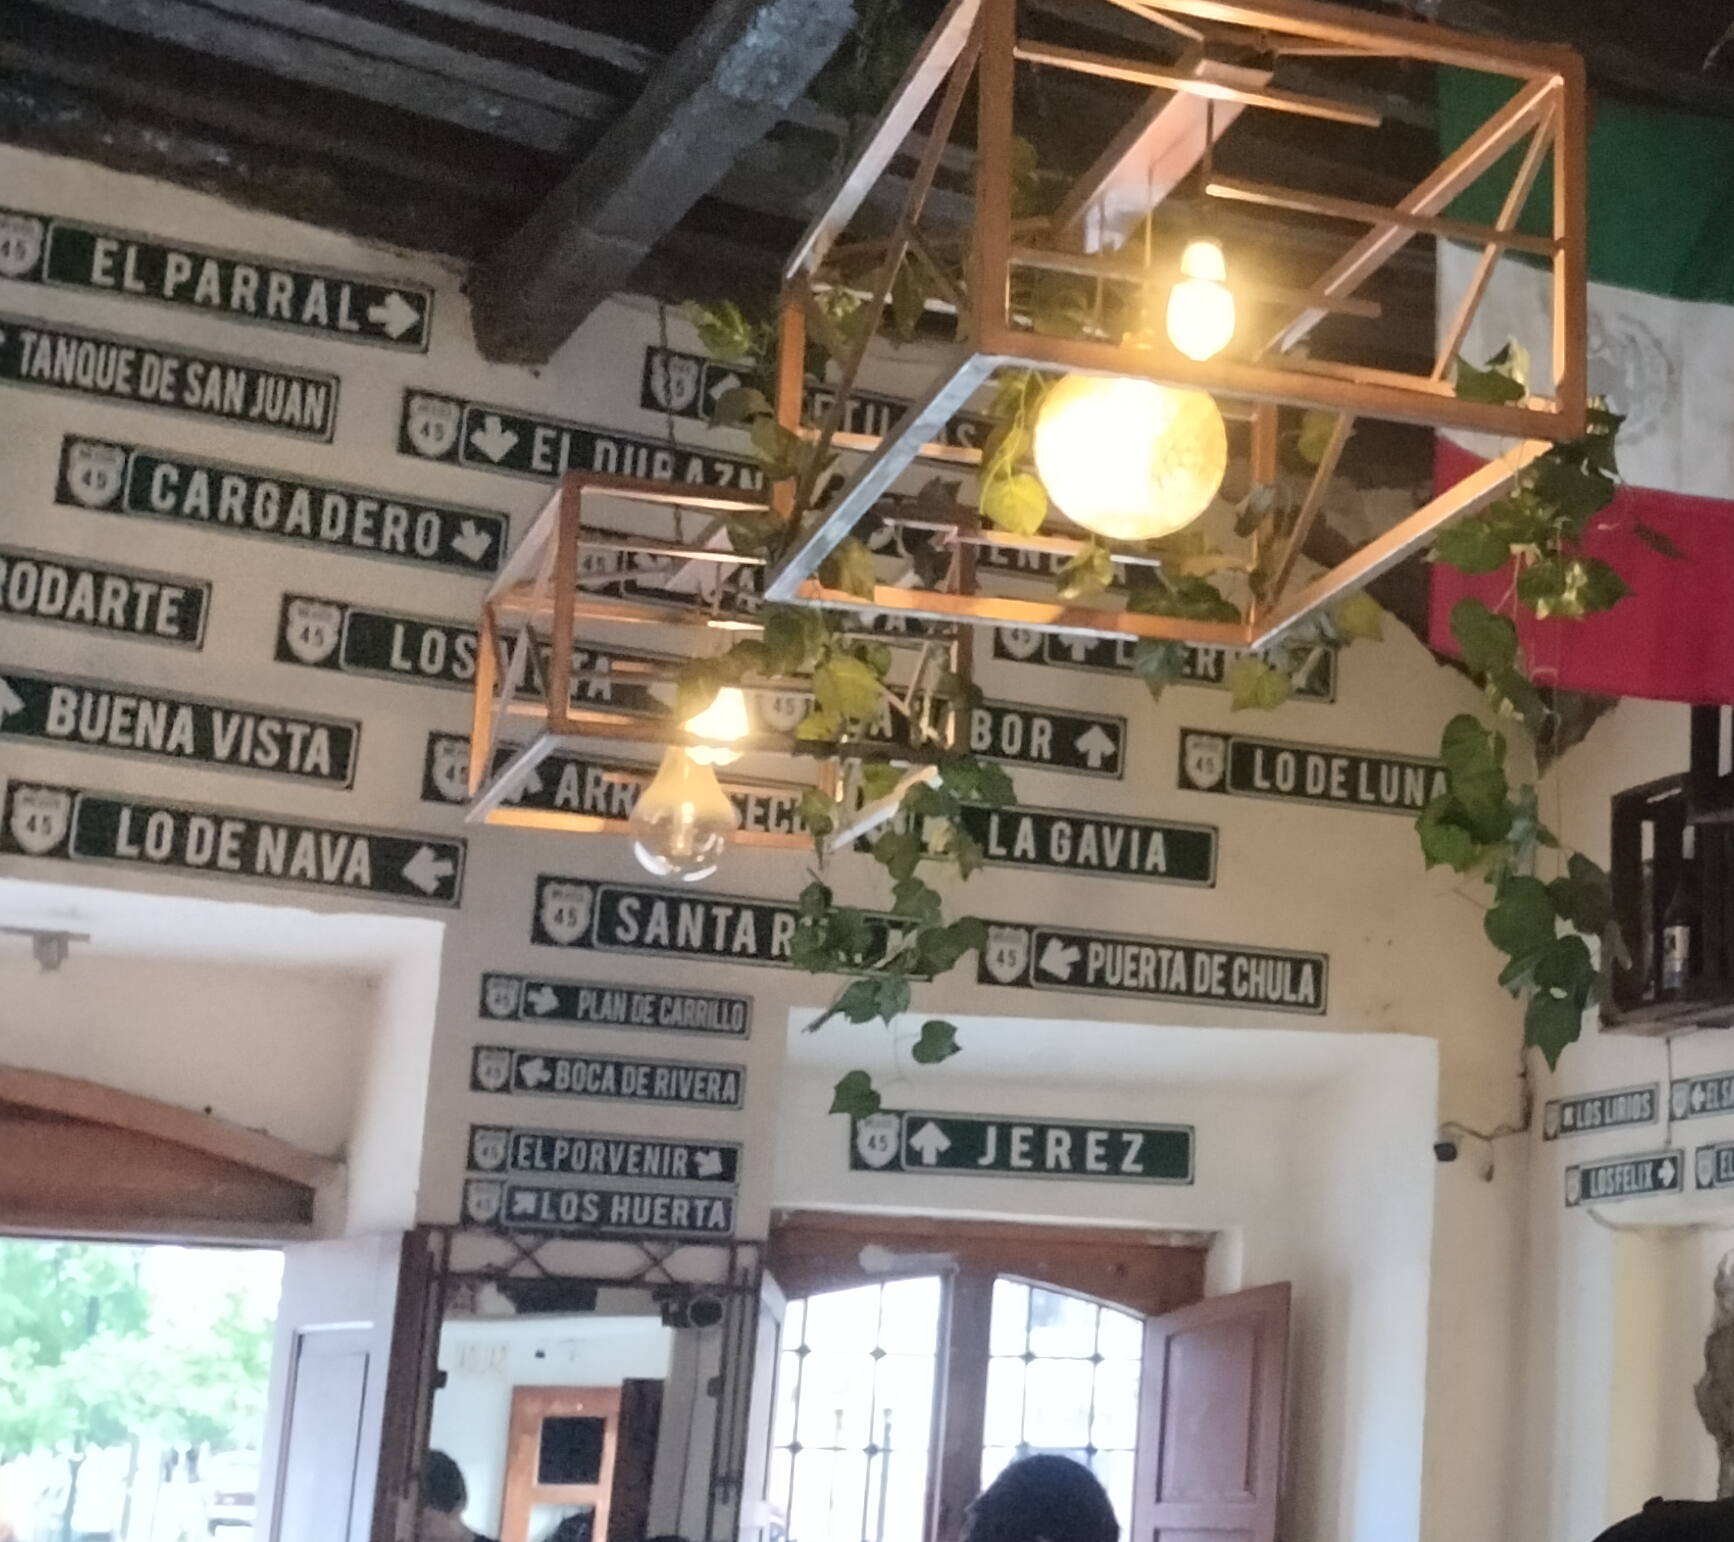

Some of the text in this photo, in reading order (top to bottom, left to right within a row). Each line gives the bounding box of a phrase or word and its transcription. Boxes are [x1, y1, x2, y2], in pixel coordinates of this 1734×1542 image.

[91, 237, 362, 334] EL PARRAL
[19, 330, 329, 429] TANQUE DE SAN JUAN
[150, 465, 442, 558] CARGADERO
[389, 622, 477, 680] LOS
[46, 686, 332, 778] BUENA VISTA
[1253, 747, 1448, 809] LO DE LUNA
[115, 805, 371, 889] LO DE NAVA
[988, 814, 1167, 873] LA GAVIA
[551, 905, 578, 929] 45
[614, 896, 758, 954] SANTA
[995, 946, 1018, 970] 45
[1087, 941, 1315, 1004] PUERTA DE CHULA
[576, 988, 744, 1032] PLAN DE CARRILLO
[554, 1060, 737, 1103] BOCA DE RIVERA
[518, 1136, 547, 1168] EL
[553, 1141, 688, 1178] PORVENIR
[866, 1131, 890, 1153] 45
[977, 1124, 1144, 1172] JEREZ
[541, 1191, 726, 1228] LOS HUERTA
